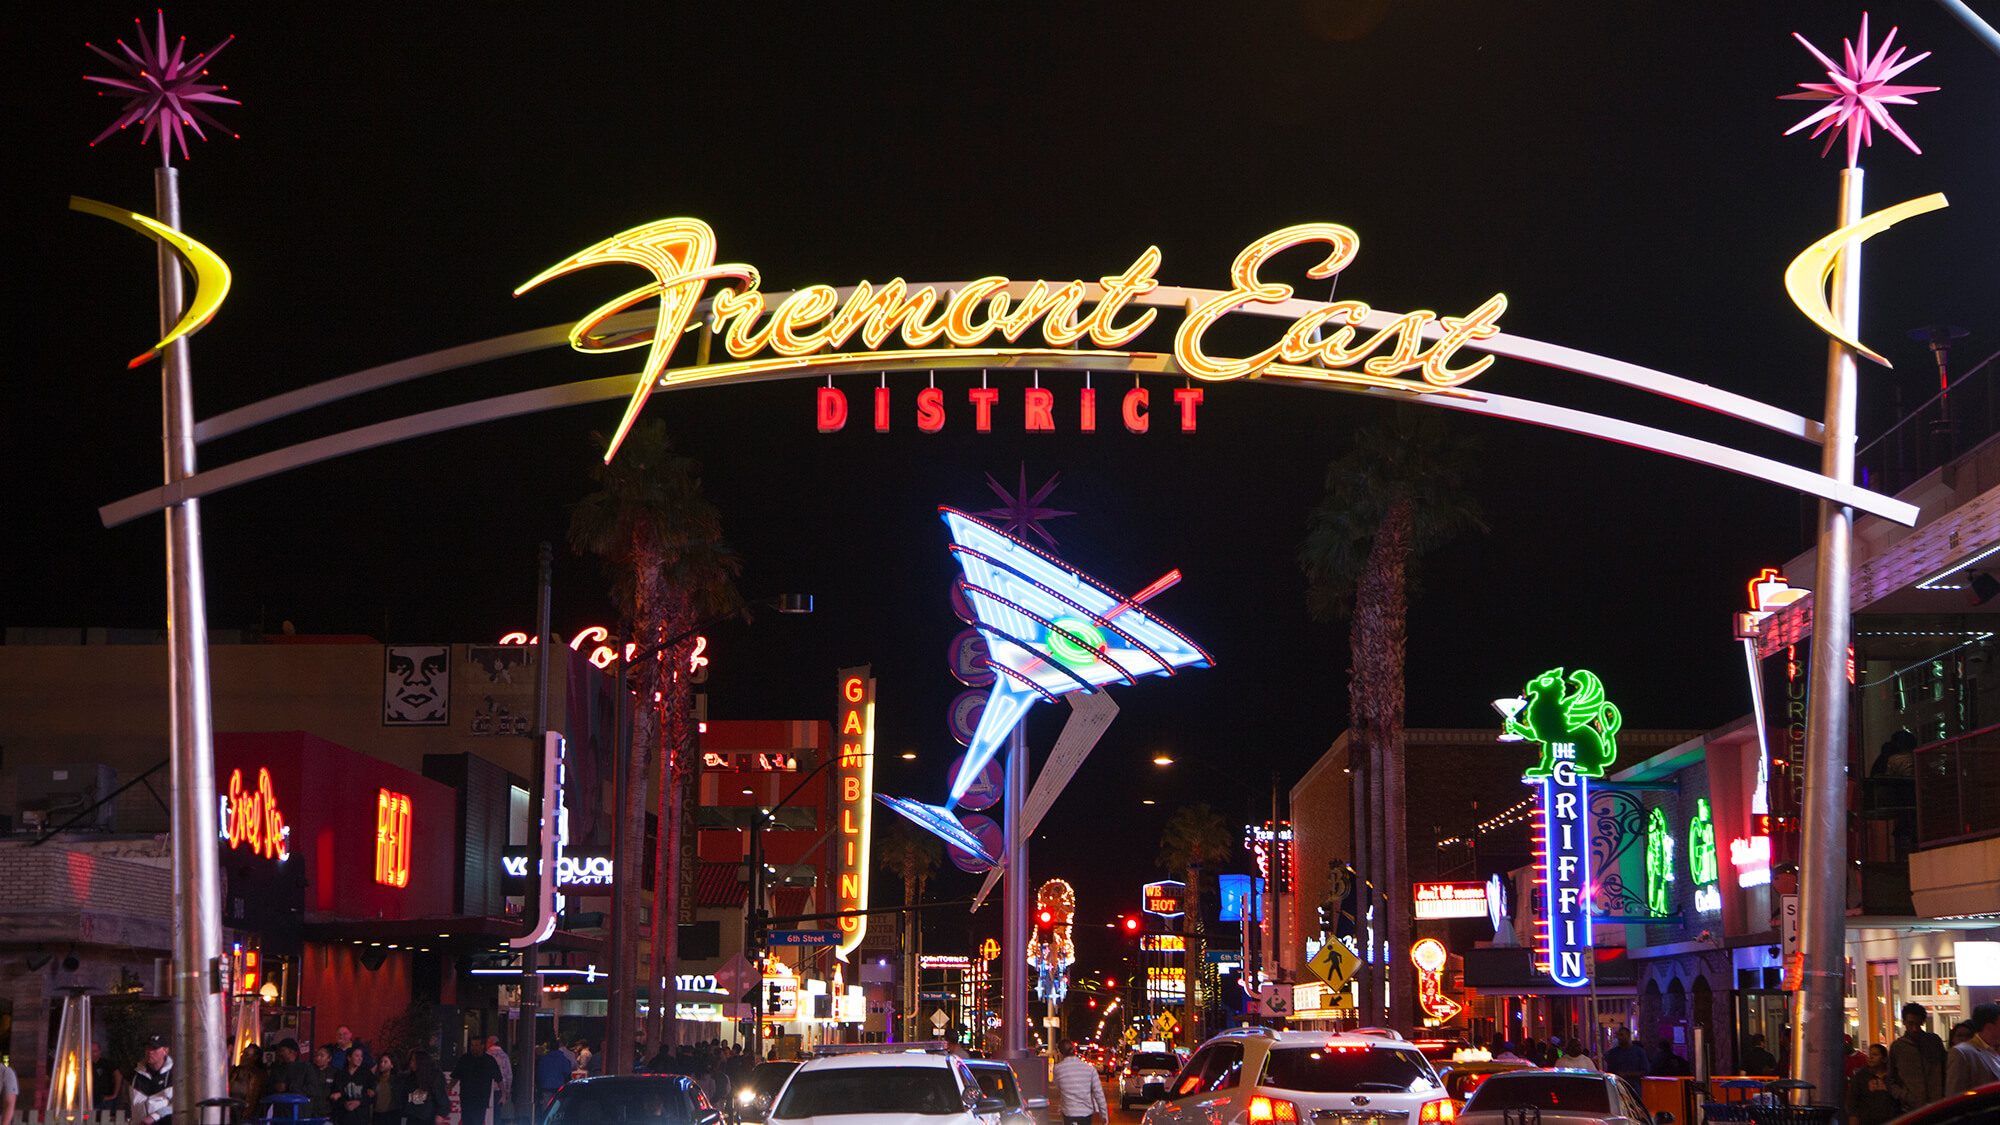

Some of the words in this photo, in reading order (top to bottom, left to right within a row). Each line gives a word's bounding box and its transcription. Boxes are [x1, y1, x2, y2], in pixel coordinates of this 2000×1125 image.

[513, 217, 1162, 464] Fremont
[1174, 222, 1508, 384] East
[817, 387, 1203, 433] DISTRICT
[838, 677, 863, 933] GAMBLING
[1552, 742, 1576, 760] THE
[1552, 761, 1584, 978] GRIFFIN
[787, 934, 800, 943] 6th
[802, 934, 825, 943] Street
